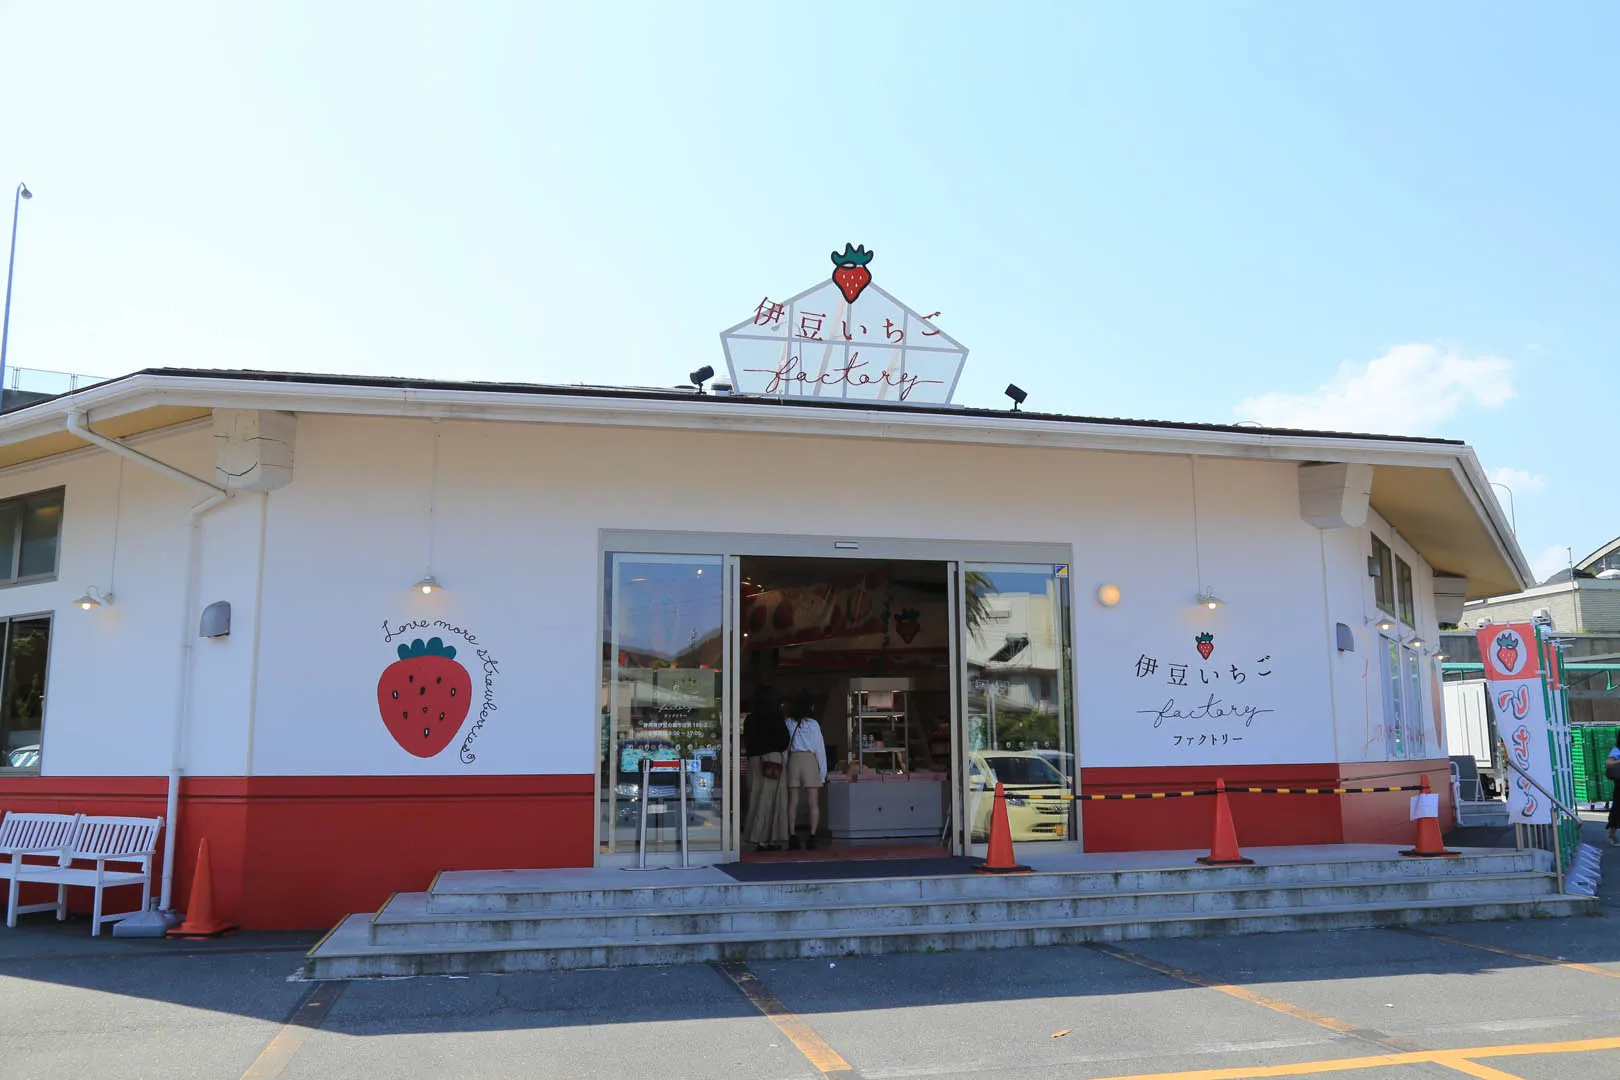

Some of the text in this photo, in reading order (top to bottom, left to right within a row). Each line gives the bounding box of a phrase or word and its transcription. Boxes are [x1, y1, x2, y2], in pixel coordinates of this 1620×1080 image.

[754, 296, 941, 344] 伊豆いちご
[743, 352, 945, 402] factory
[1135, 654, 1272, 686] 伊豆いちご
[382, 619, 500, 764] Love more strawberries
[1136, 693, 1275, 728] factory
[1173, 733, 1243, 746] ファクトリー
